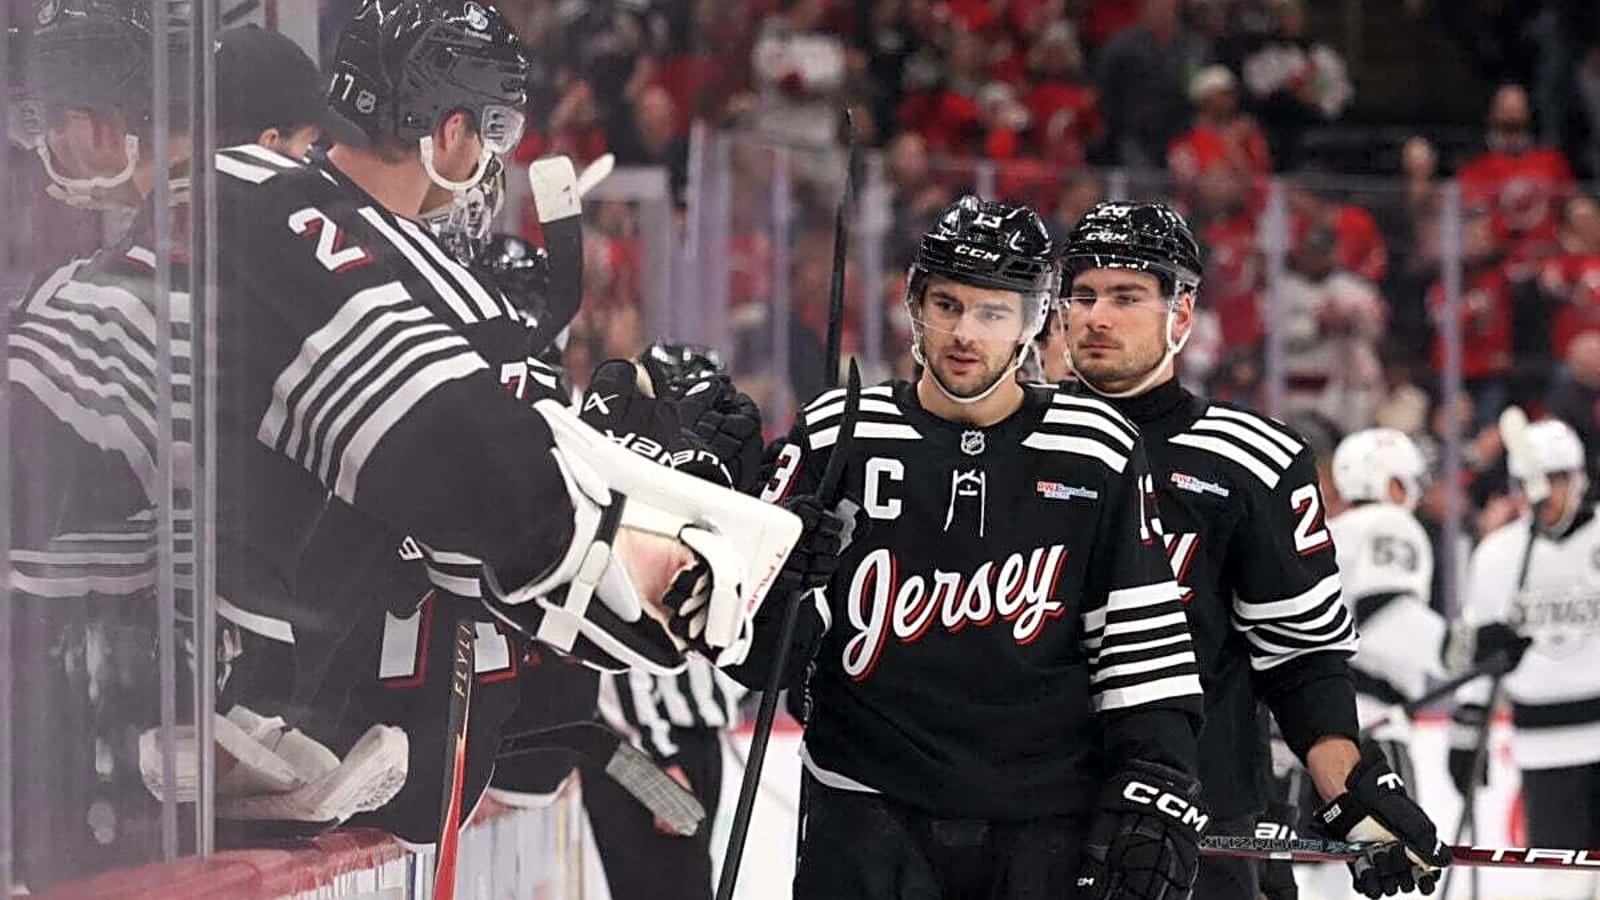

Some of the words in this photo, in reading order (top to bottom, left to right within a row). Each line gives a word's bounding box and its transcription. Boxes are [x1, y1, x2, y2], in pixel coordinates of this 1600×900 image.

[288, 206, 371, 272] 2
[954, 244, 1001, 261] CCM
[864, 457, 904, 520] C
[842, 545, 1068, 681] Jersey
[1121, 780, 1210, 833] CCM
[1322, 803, 1343, 824] 28
